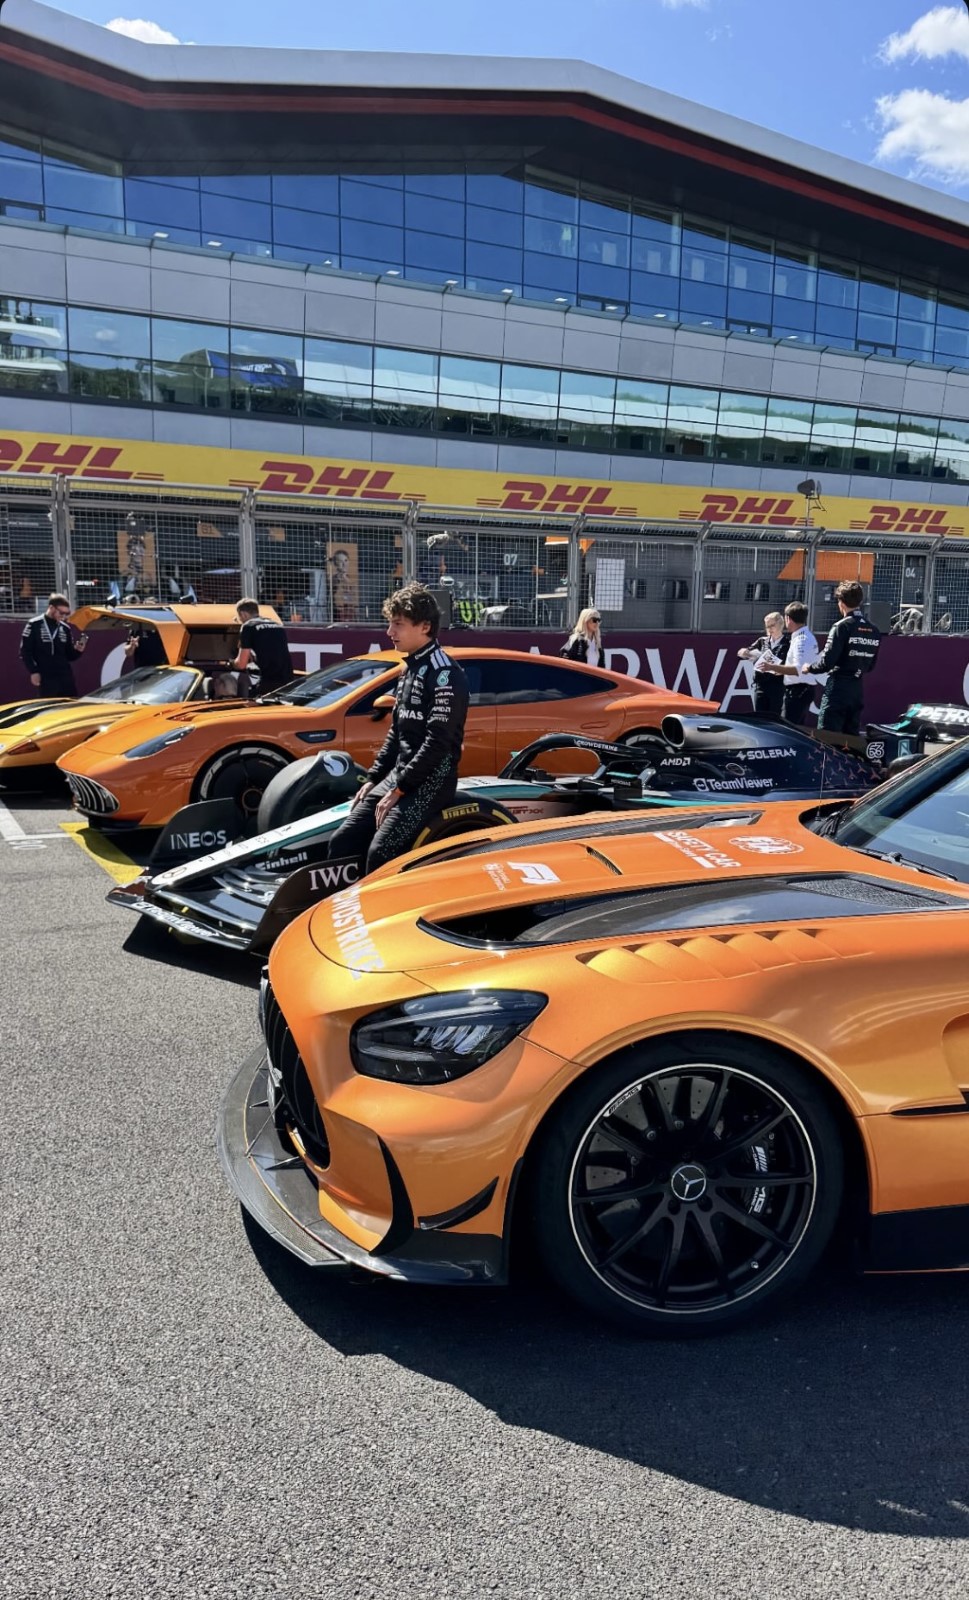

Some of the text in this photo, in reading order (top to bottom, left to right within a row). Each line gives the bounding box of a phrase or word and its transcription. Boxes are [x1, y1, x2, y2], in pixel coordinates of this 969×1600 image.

[259, 461, 402, 500] DHL
[500, 481, 617, 515] DHL
[700, 494, 798, 526] DHL
[865, 506, 950, 534] DHL
[503, 554, 518, 566] 07
[905, 567, 916, 578] 04
[849, 637, 880, 647] PETRONAS
[576, 740, 619, 752] CROWDSTRIKE
[746, 748, 790, 760] SOLERA
[866, 741, 885, 759] 63
[660, 758, 683, 767] AMD
[707, 777, 774, 791] TeamViewer
[442, 803, 480, 820] PIRELLI
[170, 830, 227, 850] INEOS
[667, 831, 717, 852] SAFETY
[704, 852, 742, 868] CAR
[255, 851, 308, 871] Einhell
[308, 862, 360, 891] IWC
[506, 861, 561, 885] F1
